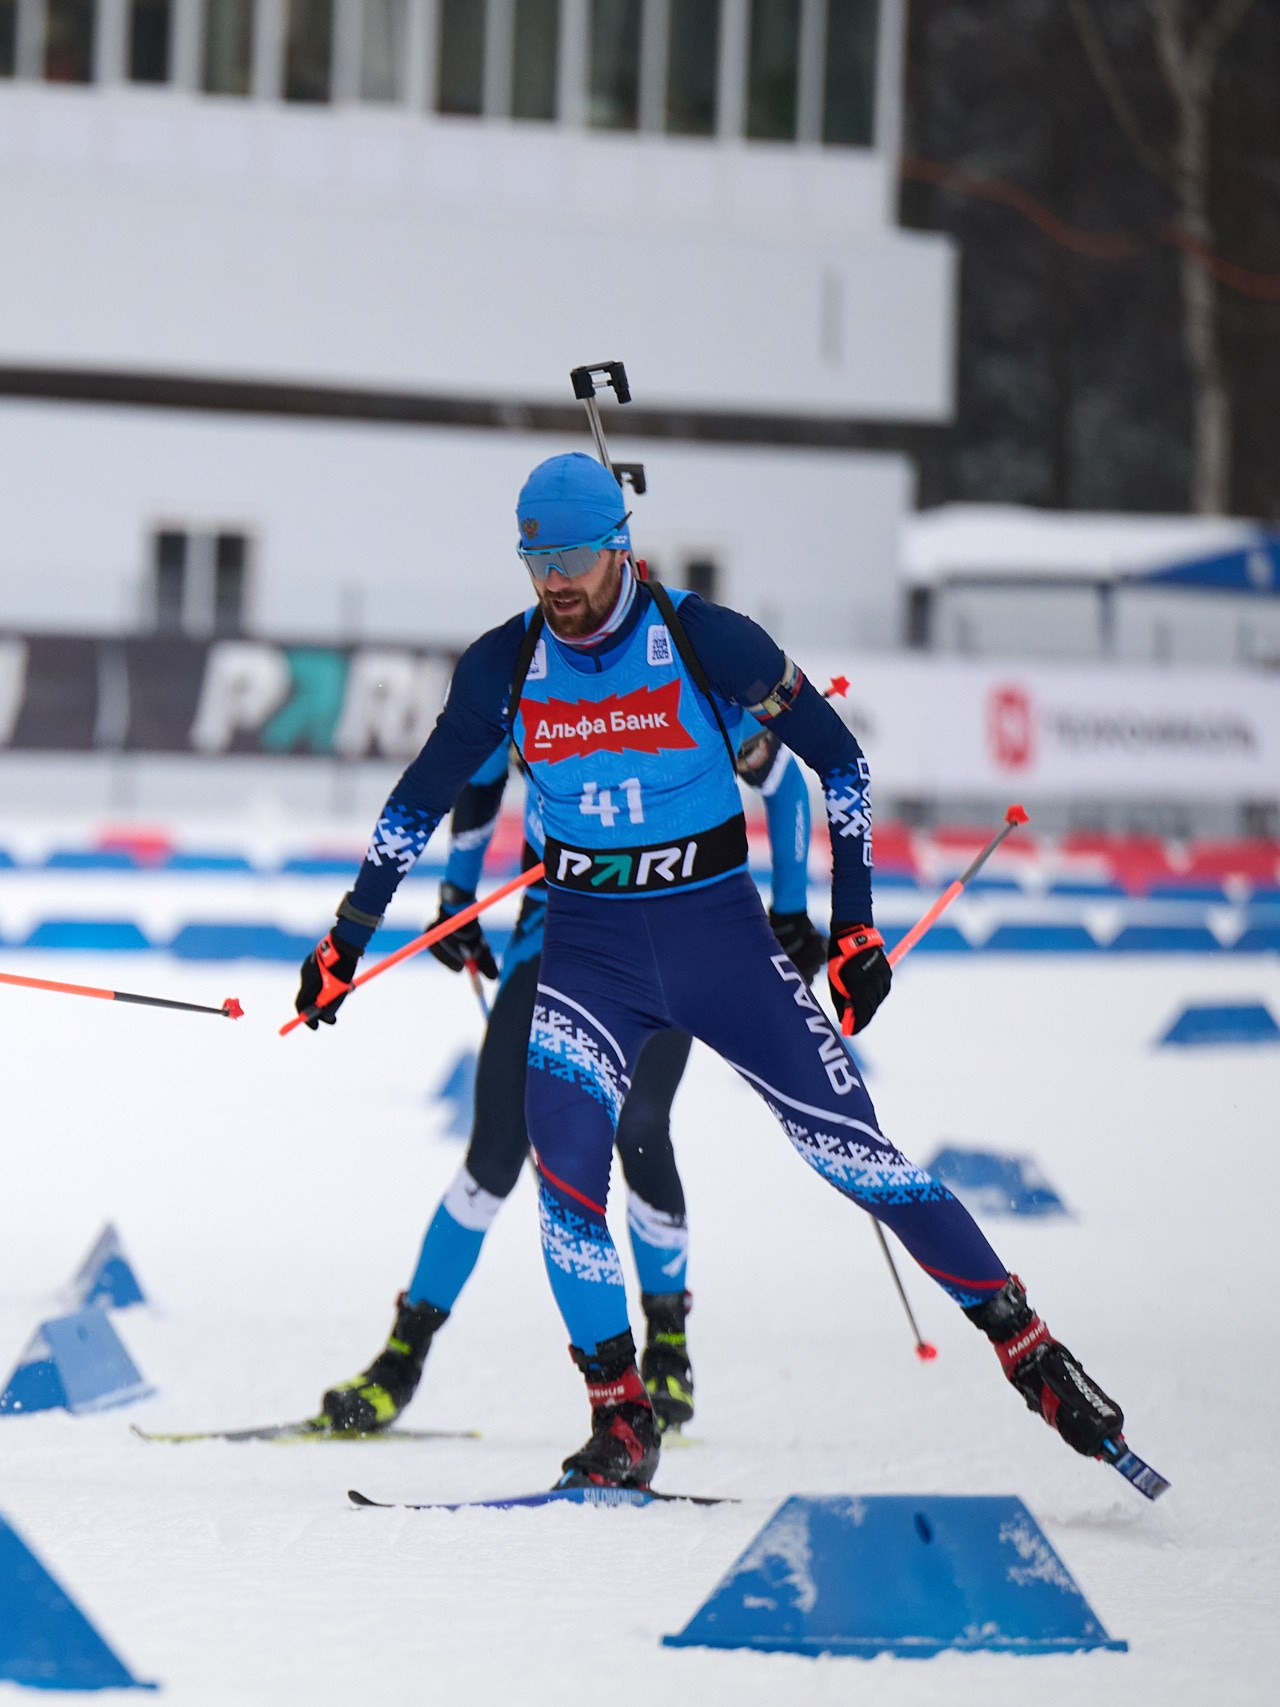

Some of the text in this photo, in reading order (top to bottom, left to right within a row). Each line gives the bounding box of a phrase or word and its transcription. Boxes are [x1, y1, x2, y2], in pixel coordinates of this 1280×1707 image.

[534, 709, 669, 748] Альфа Банк
[578, 777, 644, 827] 41
[556, 841, 698, 886] PARI
[770, 954, 861, 1096] ЯМАЛ
